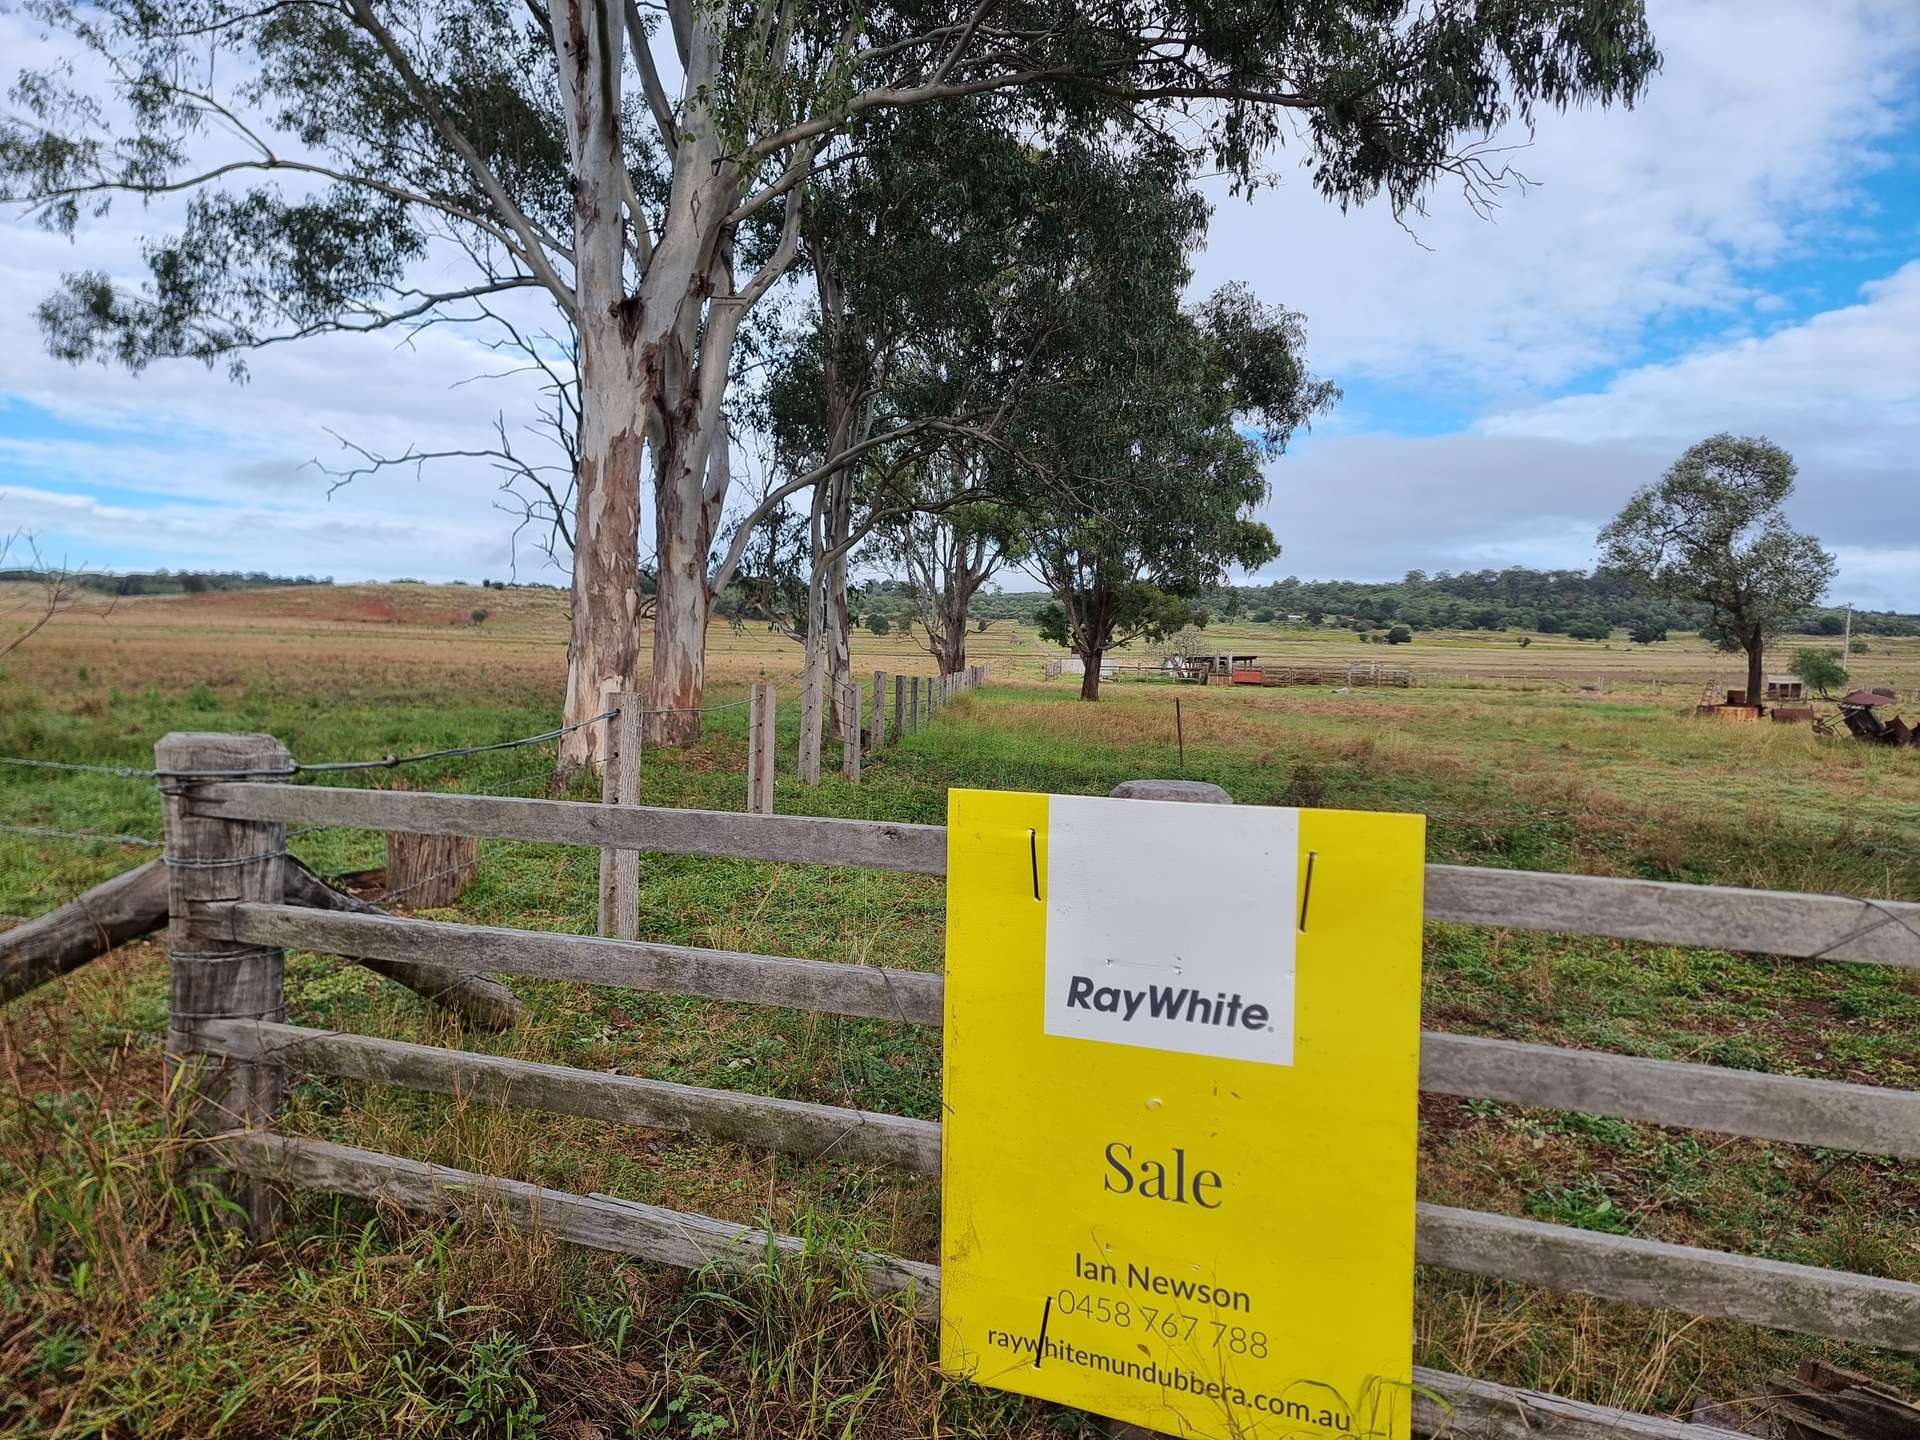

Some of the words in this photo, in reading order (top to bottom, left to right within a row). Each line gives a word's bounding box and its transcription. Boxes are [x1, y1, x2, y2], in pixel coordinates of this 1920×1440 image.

[1103, 1141, 1223, 1210] Sale
[1074, 1252, 1117, 1285] Ian
[1127, 1262, 1251, 1313] Newson
[1057, 1288, 1132, 1329] 0458
[1142, 1305, 1199, 1343] 767
[1210, 1320, 1269, 1360] 788
[987, 1326, 1352, 1432] raywhitemundubbera.com.au
